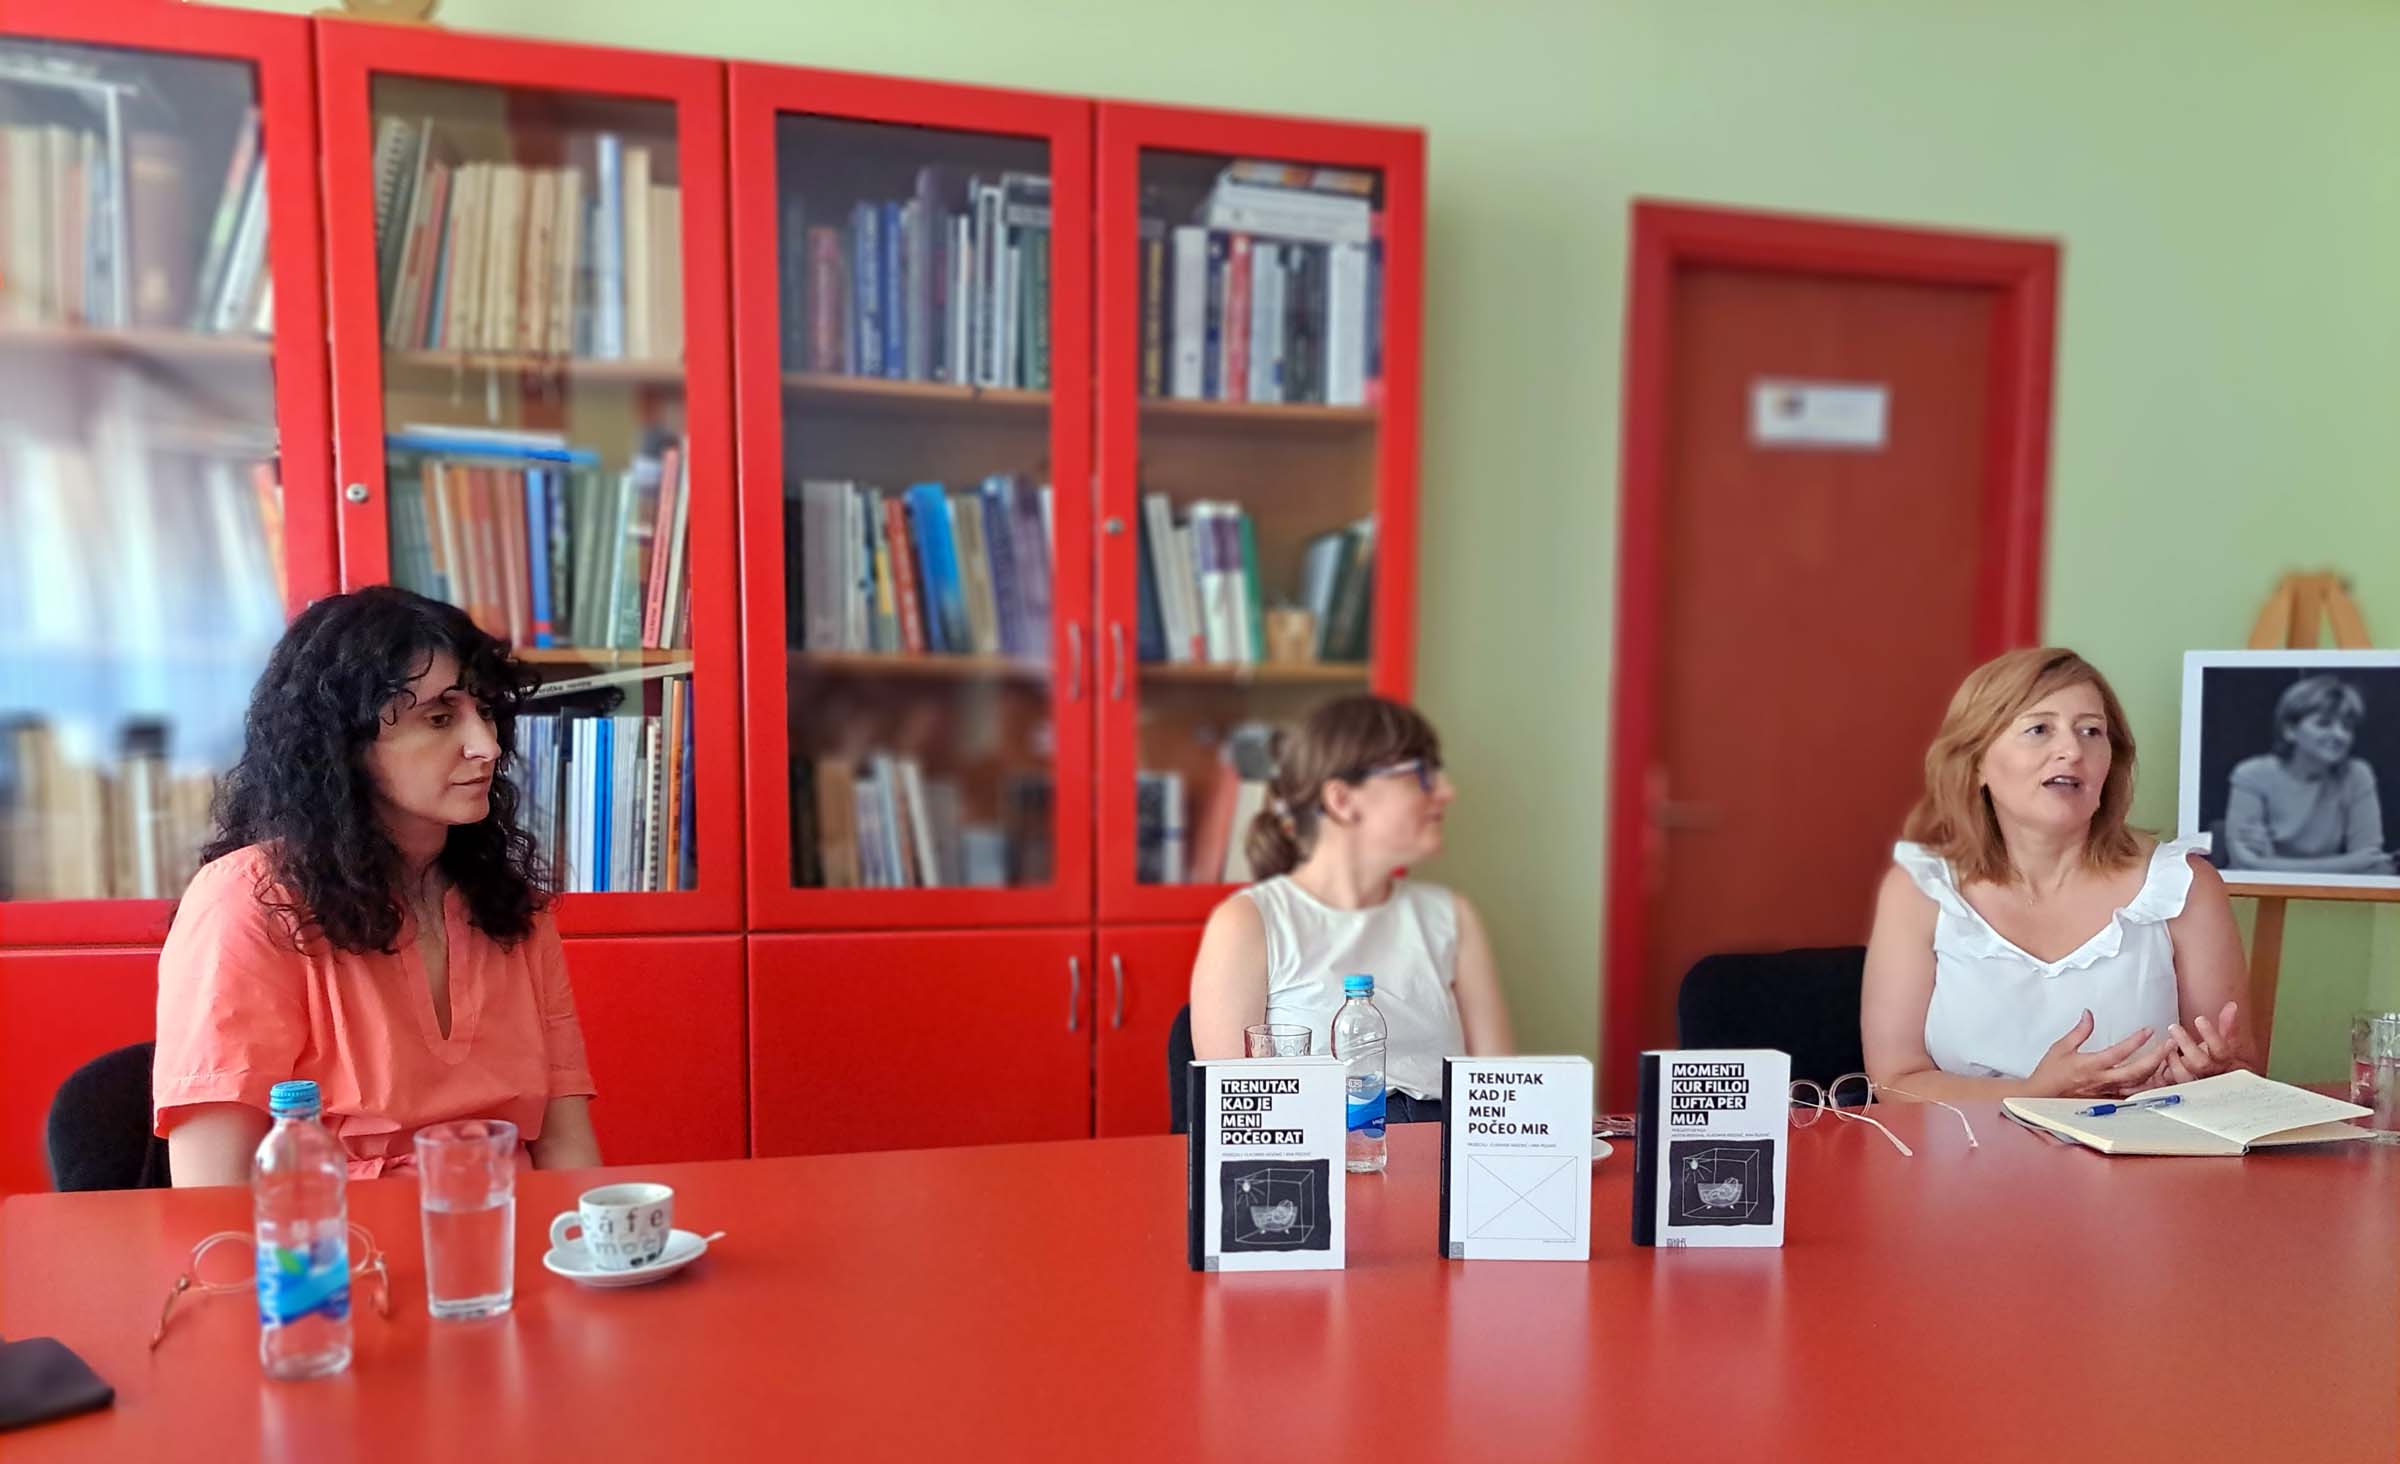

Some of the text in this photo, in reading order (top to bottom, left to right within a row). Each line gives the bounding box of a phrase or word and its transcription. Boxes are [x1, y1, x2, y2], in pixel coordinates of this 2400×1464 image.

[1672, 1064, 1743, 1077] MOMENTI
[1468, 1072, 1544, 1085] TRENUTAK
[1221, 1079, 1298, 1093] TRENUTAK
[1672, 1080, 1747, 1093] KUR FILLOI
[1468, 1089, 1516, 1103] KAD JE
[1672, 1096, 1715, 1109] LUFTA
[1221, 1097, 1271, 1112] KAD JE
[1468, 1105, 1506, 1118] MENI
[1221, 1114, 1261, 1127] MENI
[1672, 1112, 1706, 1125] MUA
[1468, 1120, 1549, 1135] POČEO MIR
[1221, 1128, 1302, 1144] POČEO RAT
